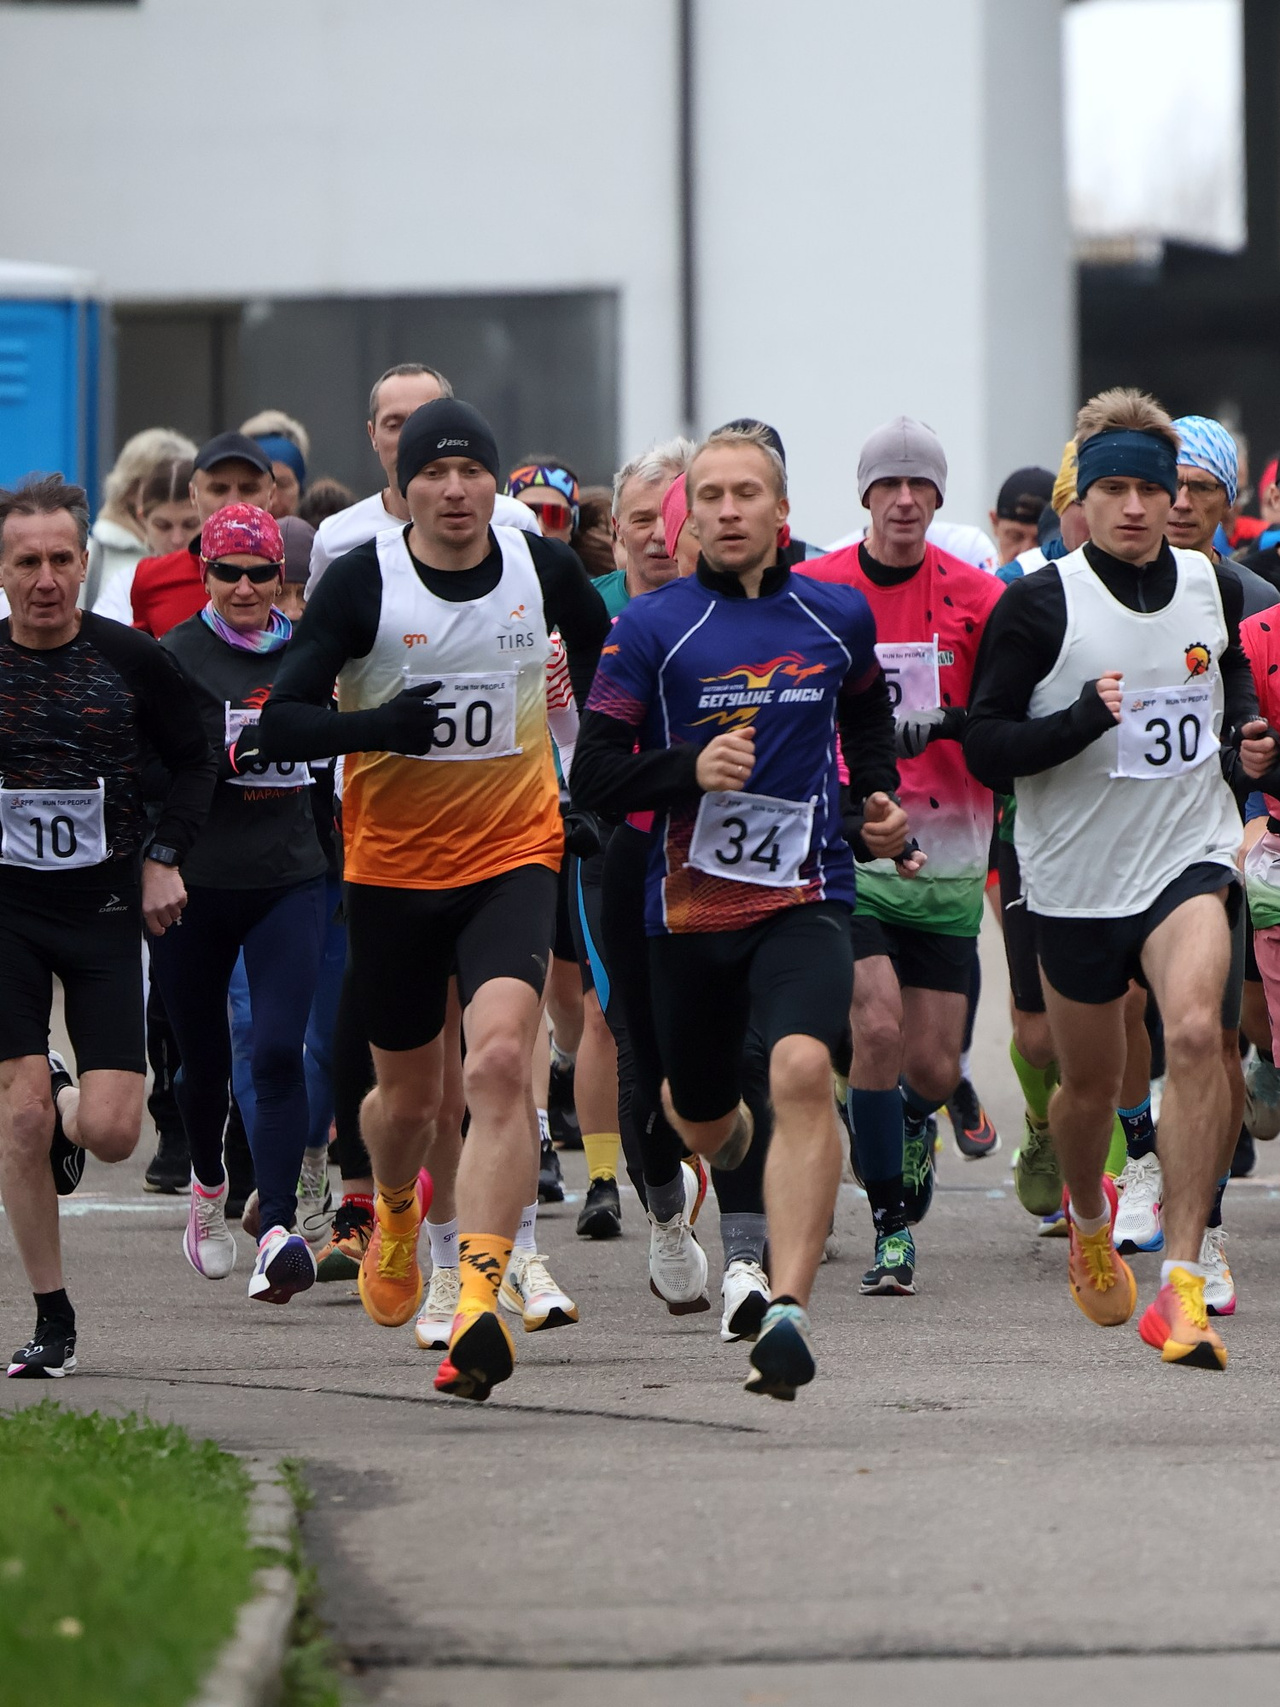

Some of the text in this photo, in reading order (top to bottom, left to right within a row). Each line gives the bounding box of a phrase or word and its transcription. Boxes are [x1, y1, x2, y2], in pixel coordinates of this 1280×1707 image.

[497, 632, 535, 650] TIRS
[480, 682, 506, 691] PEOPLE
[778, 687, 825, 703] ЛИСЫ
[432, 700, 493, 748] 50
[1144, 713, 1201, 766] 30
[67, 798, 92, 806] PEOPLE
[29, 815, 77, 859] 10
[715, 817, 781, 872] 34
[98, 905, 128, 913] DEMIX
